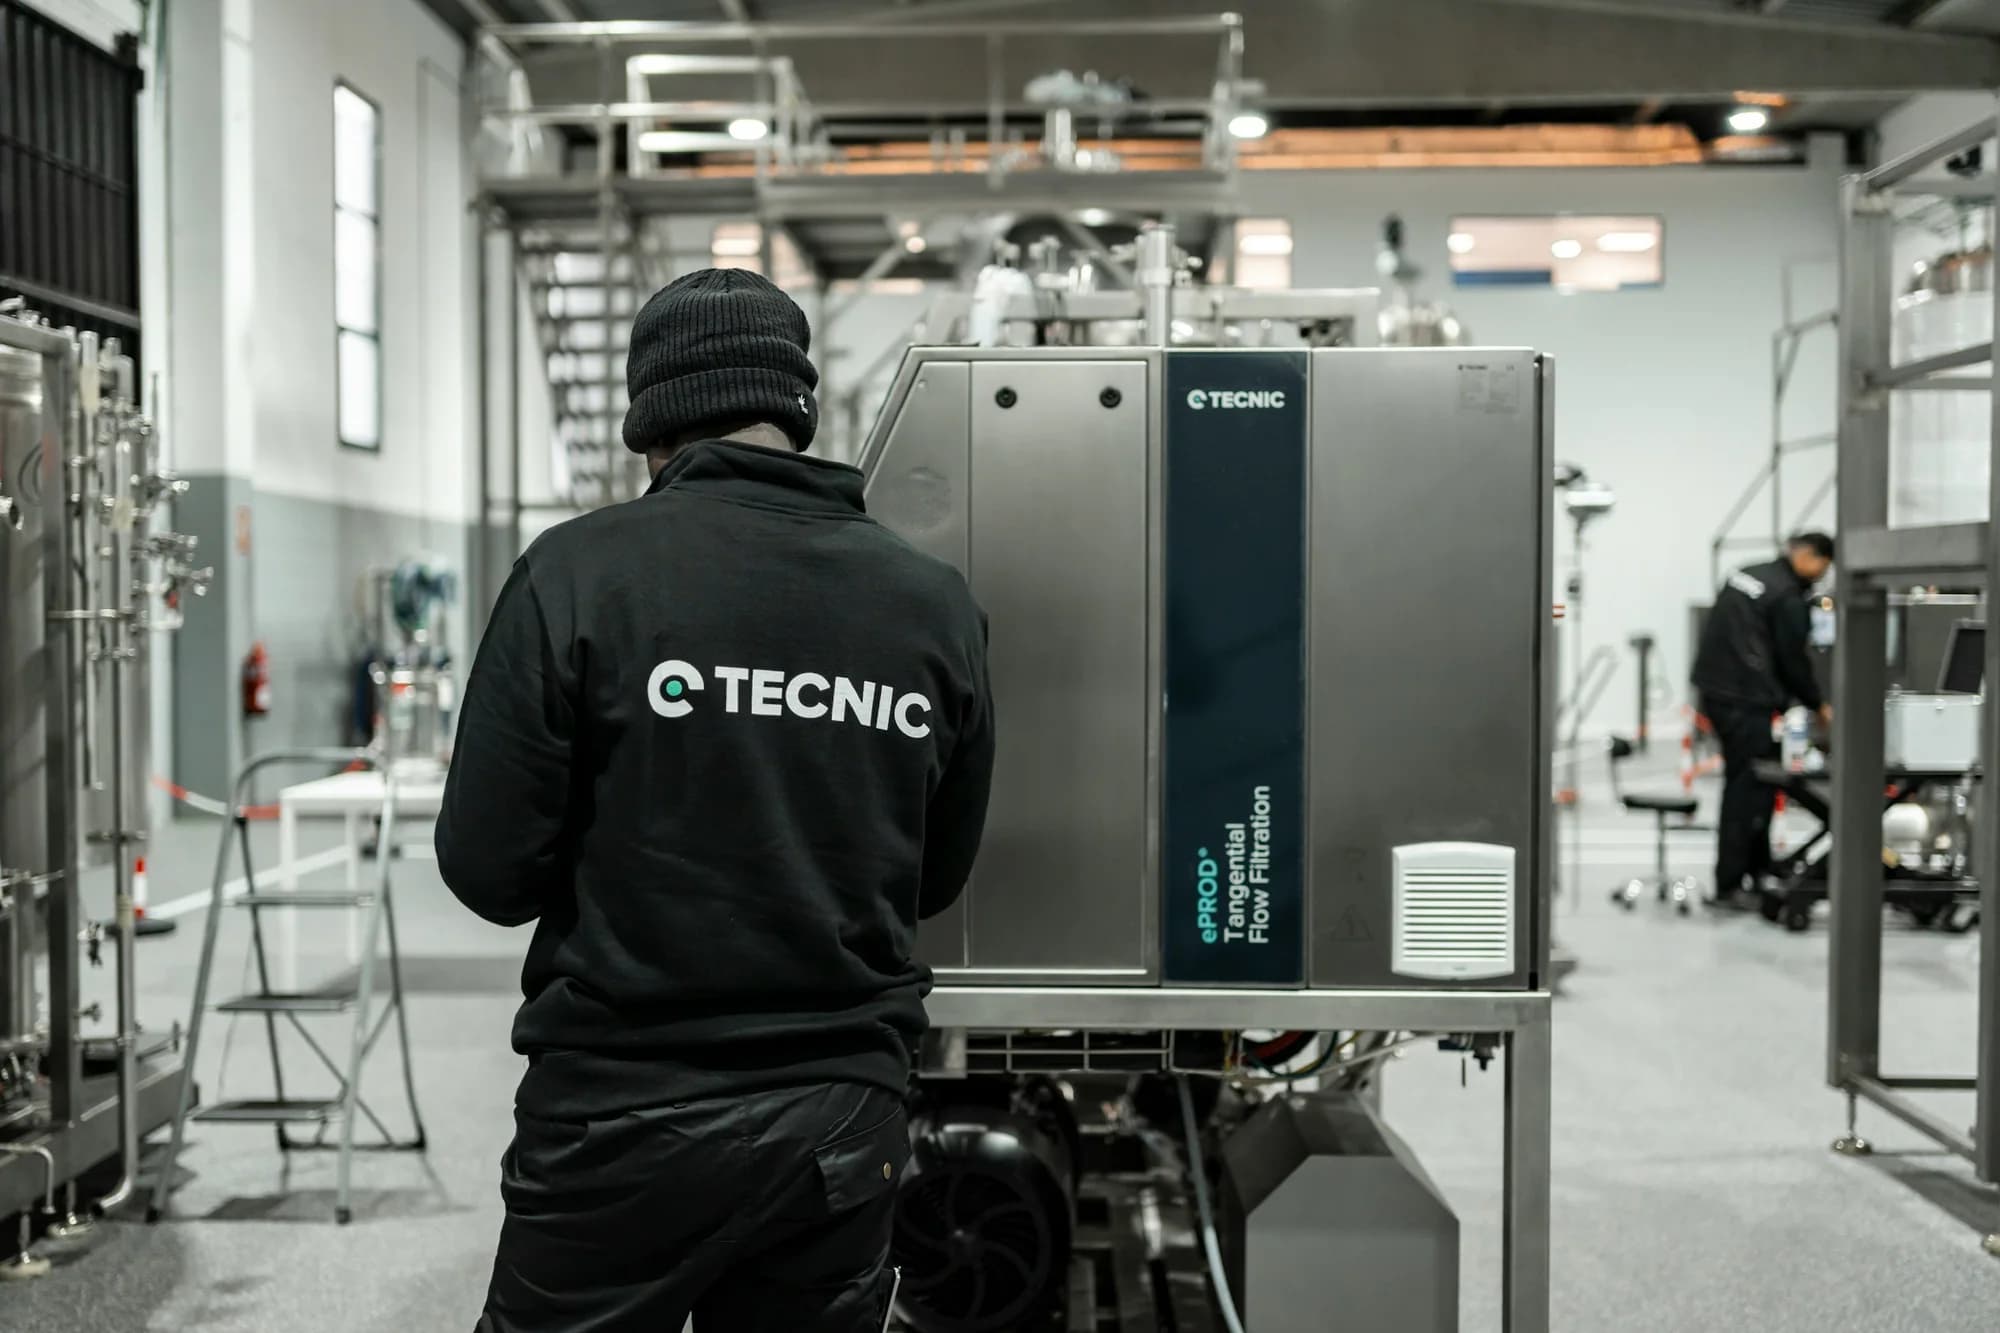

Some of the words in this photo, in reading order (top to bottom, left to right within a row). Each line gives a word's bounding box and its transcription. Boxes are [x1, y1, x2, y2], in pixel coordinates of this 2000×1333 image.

[1208, 391, 1286, 409] TECNIC
[714, 665, 932, 739] TECNIC
[1249, 785, 1271, 884] Filtration
[1224, 823, 1250, 943] Tangential
[1249, 889, 1270, 943] Flow
